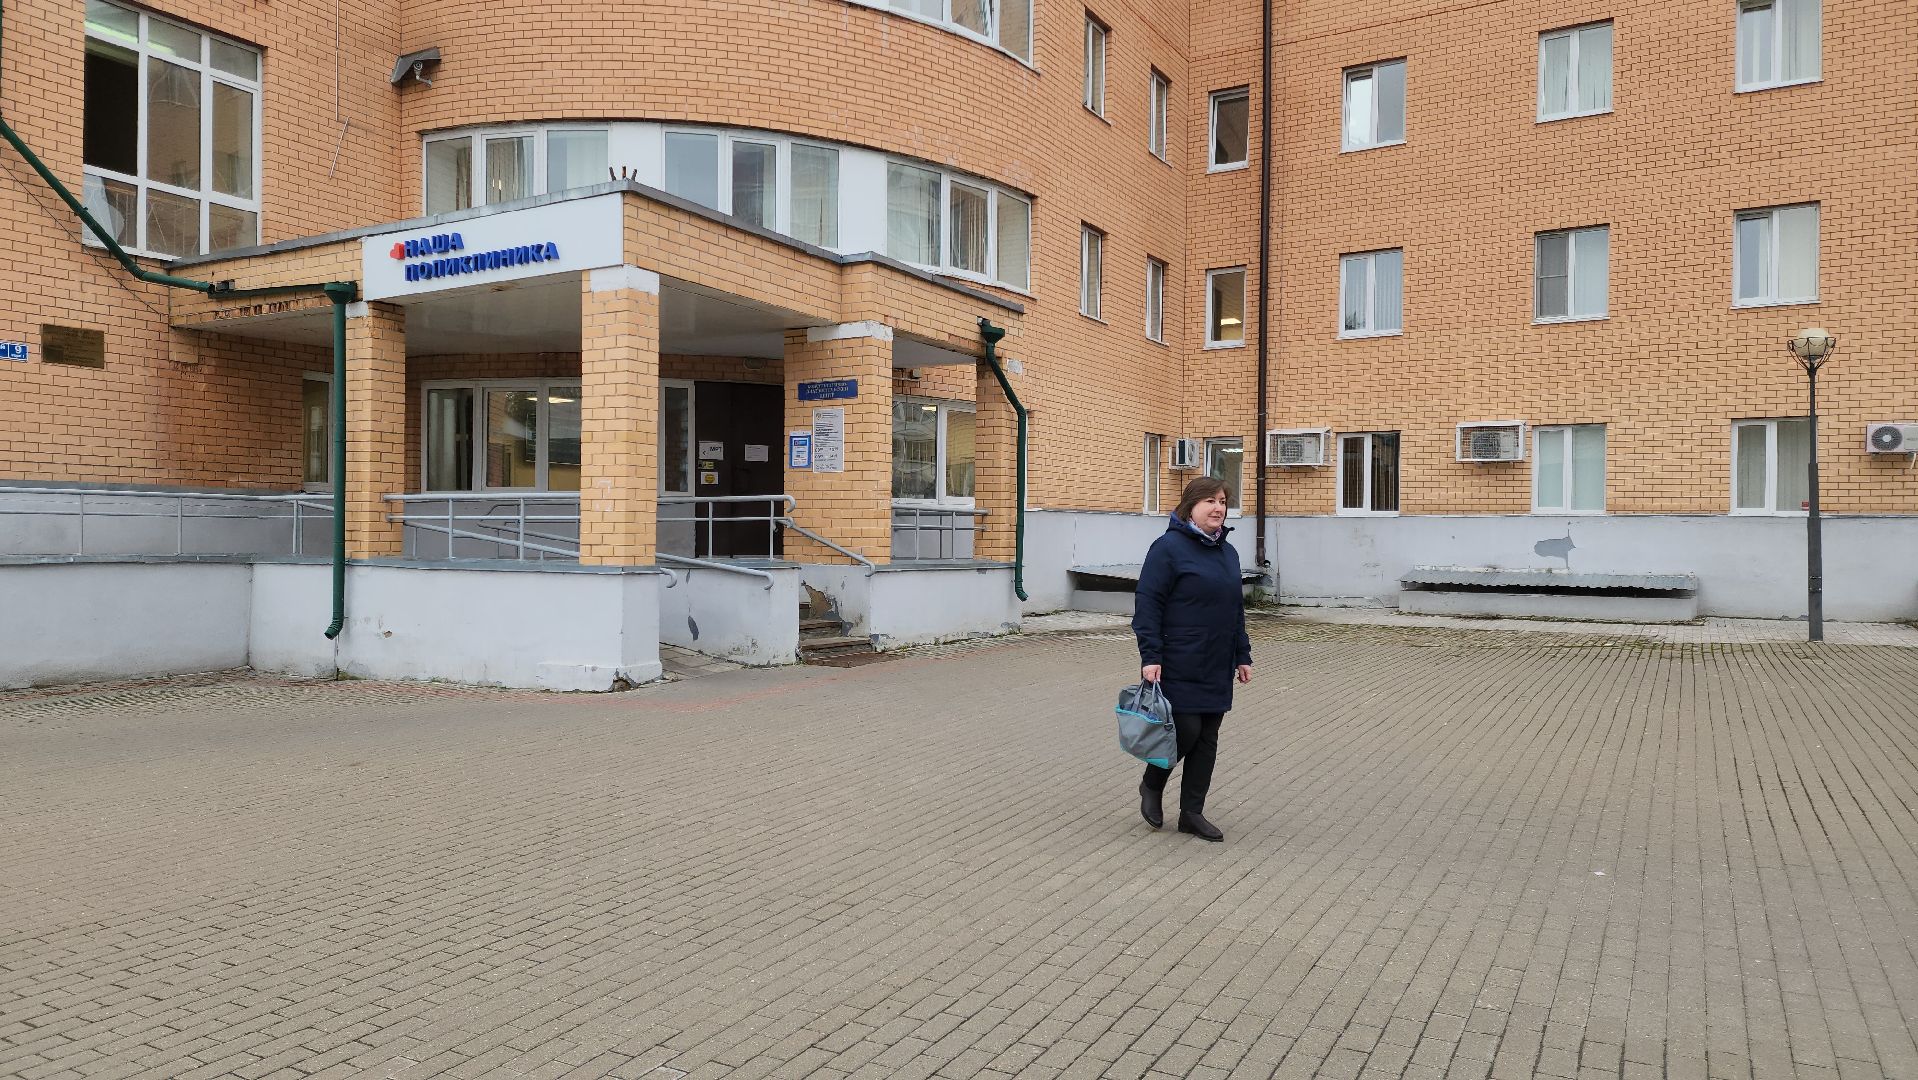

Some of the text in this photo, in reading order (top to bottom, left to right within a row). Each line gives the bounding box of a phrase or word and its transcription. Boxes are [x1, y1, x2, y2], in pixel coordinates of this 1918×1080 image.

[404, 232, 464, 258] НАША
[405, 241, 560, 282] ПОЛИКЛИНИКА
[15, 345, 22, 354] 9
